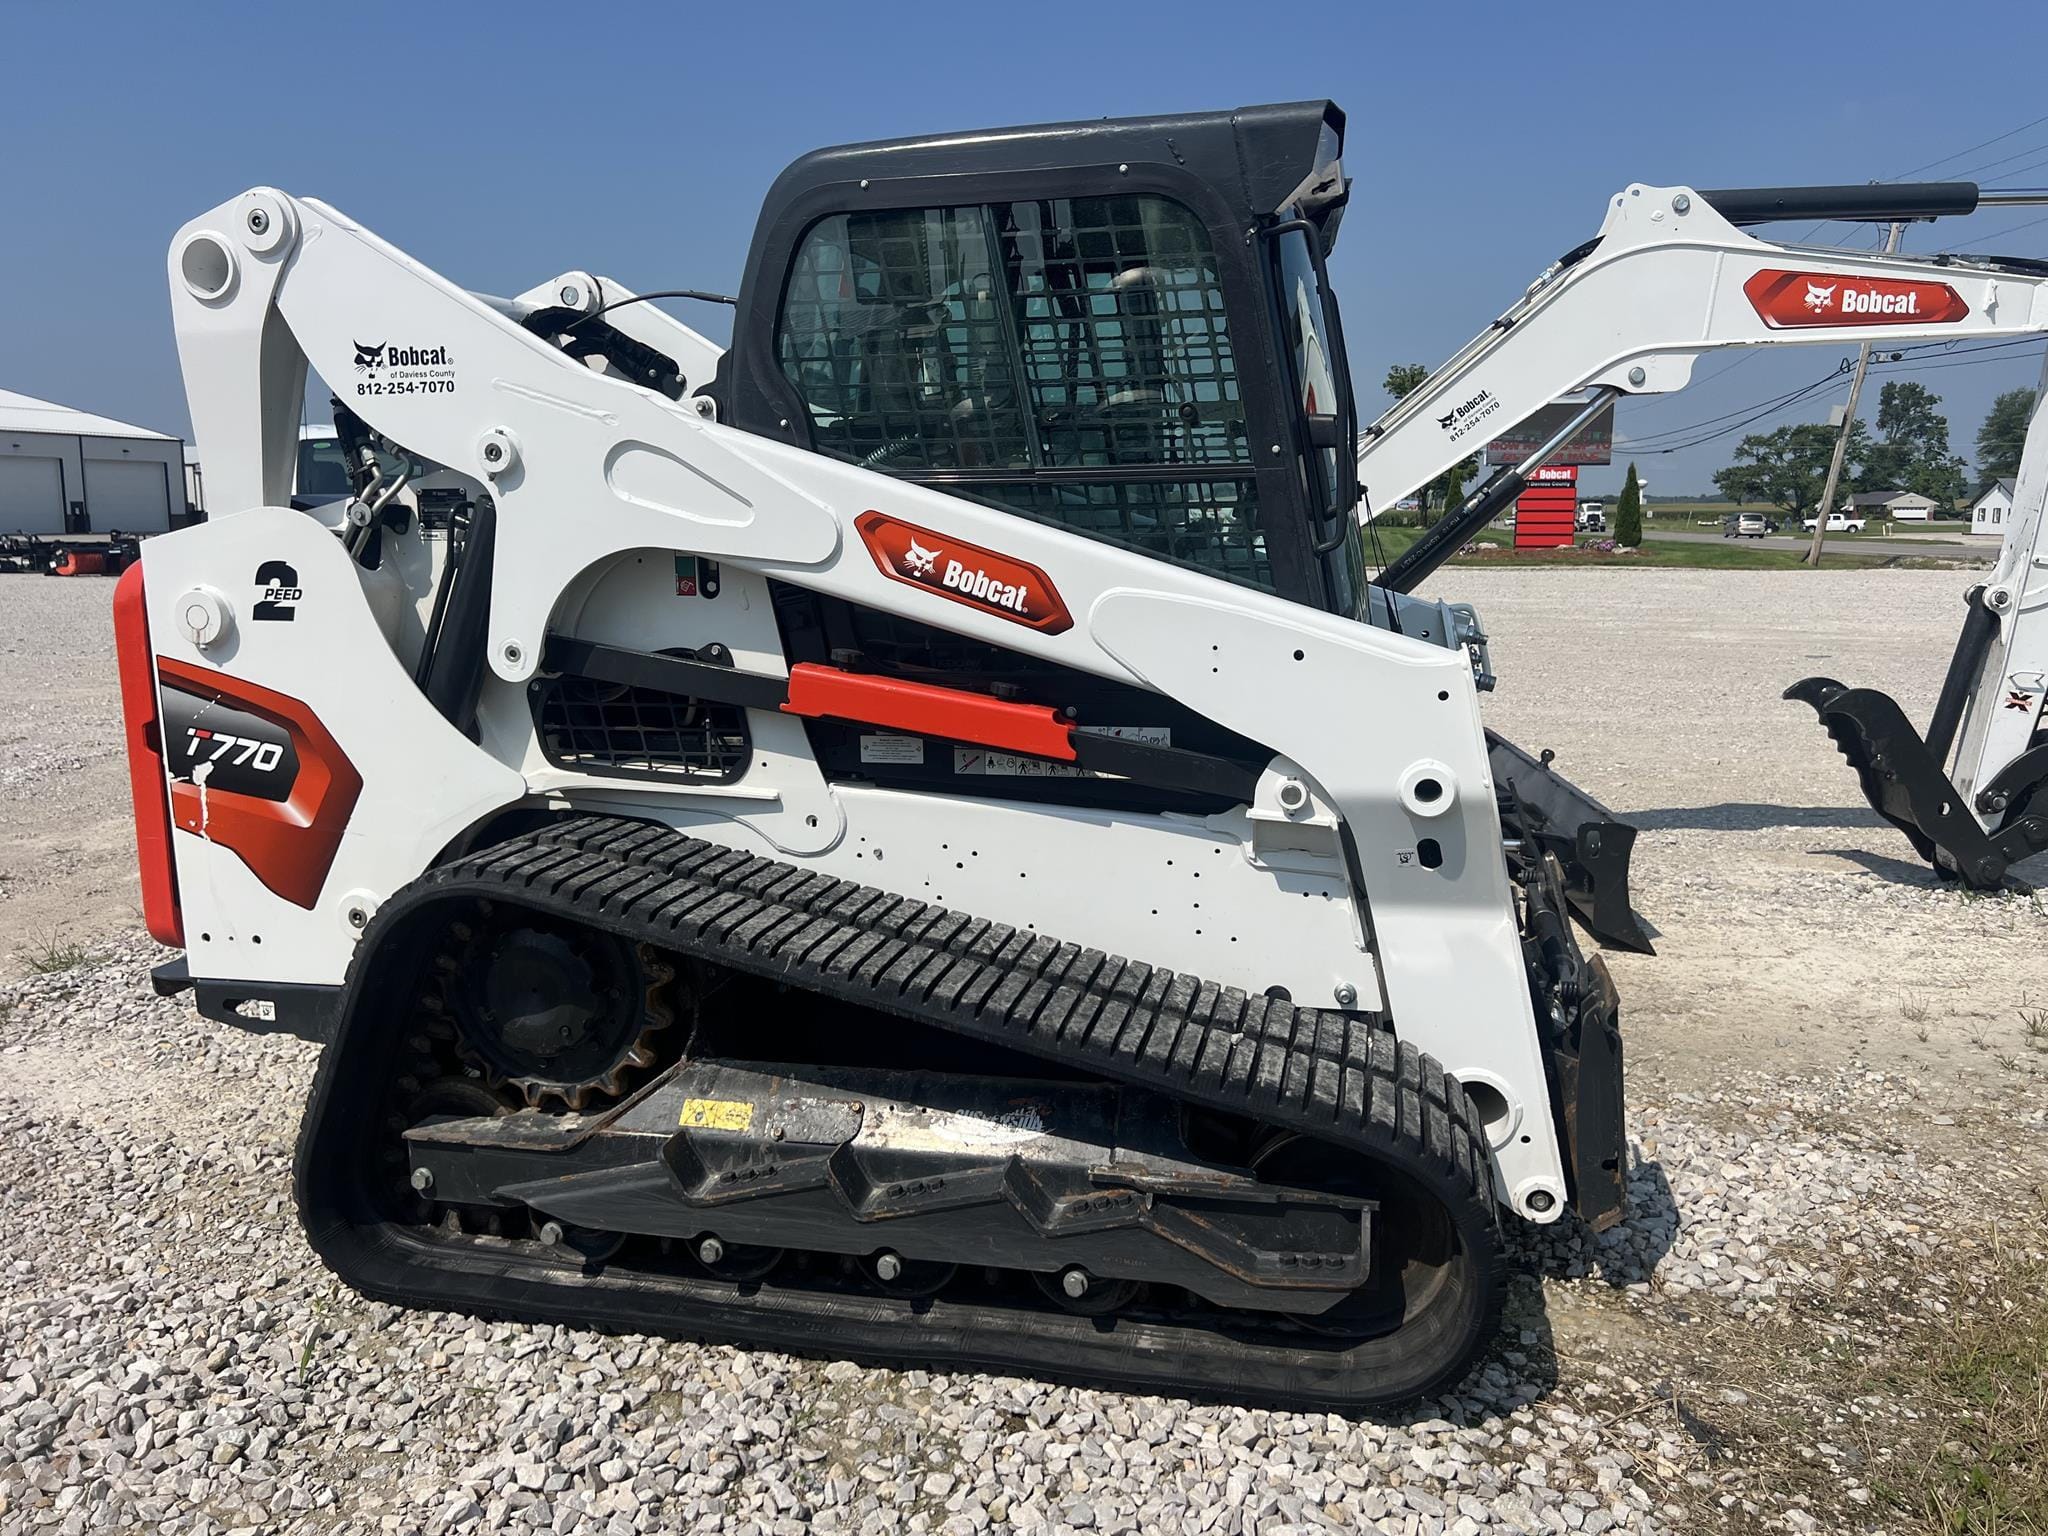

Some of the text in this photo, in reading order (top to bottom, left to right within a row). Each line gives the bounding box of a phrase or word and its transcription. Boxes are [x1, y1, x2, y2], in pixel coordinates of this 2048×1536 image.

[1841, 288, 1917, 314] Bobcat
[387, 345, 447, 367] Bobcat
[390, 369, 456, 379] of Daviess County
[357, 380, 455, 395] 812-254-7070
[1455, 389, 1490, 418] Bobcat
[1449, 401, 1501, 442] 812-254-7070
[1540, 469, 1572, 480] Bobcat
[942, 559, 1028, 613] Bobcat
[186, 727, 284, 772] T770
